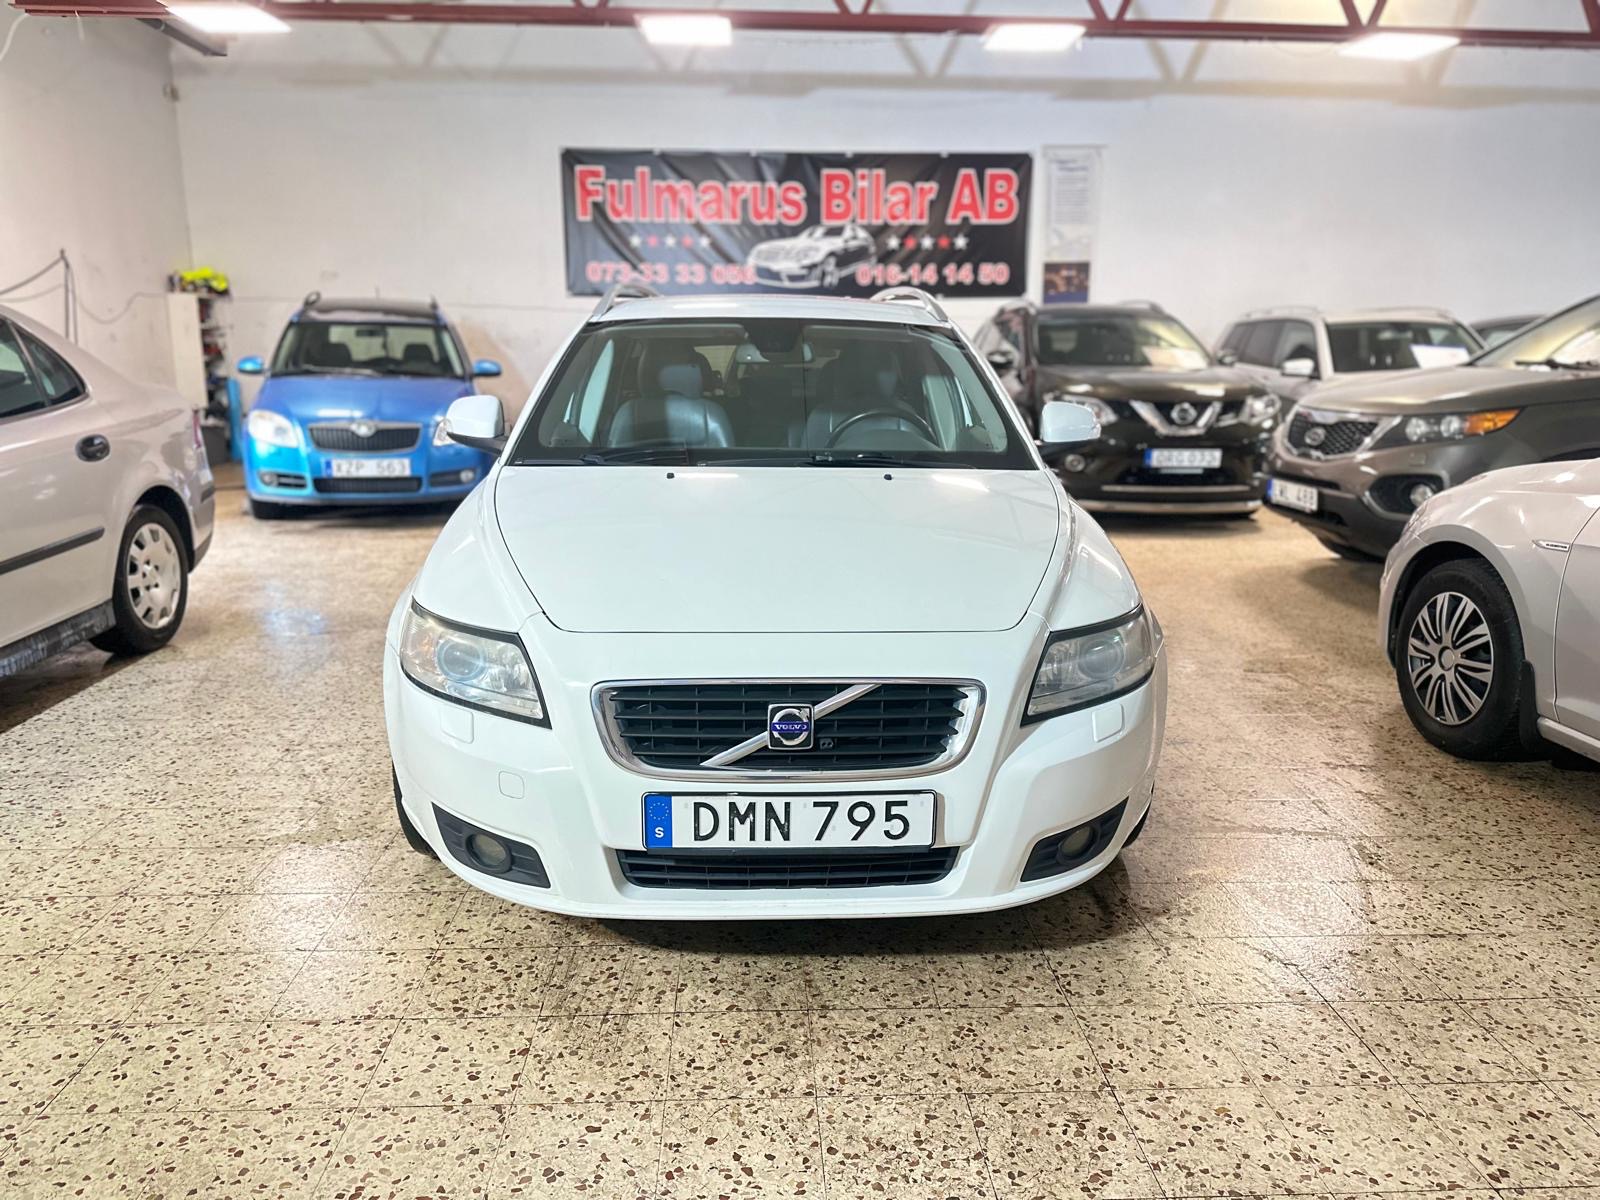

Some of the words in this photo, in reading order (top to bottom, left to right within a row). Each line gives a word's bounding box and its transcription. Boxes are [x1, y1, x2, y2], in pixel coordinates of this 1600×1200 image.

[574, 165, 807, 225] Fulmarus
[820, 168, 939, 226] Bilar
[945, 167, 1020, 225] AB
[774, 723, 808, 731] VOLVO
[654, 826, 665, 839] S
[693, 801, 791, 842] DMN
[812, 800, 910, 842] 795
